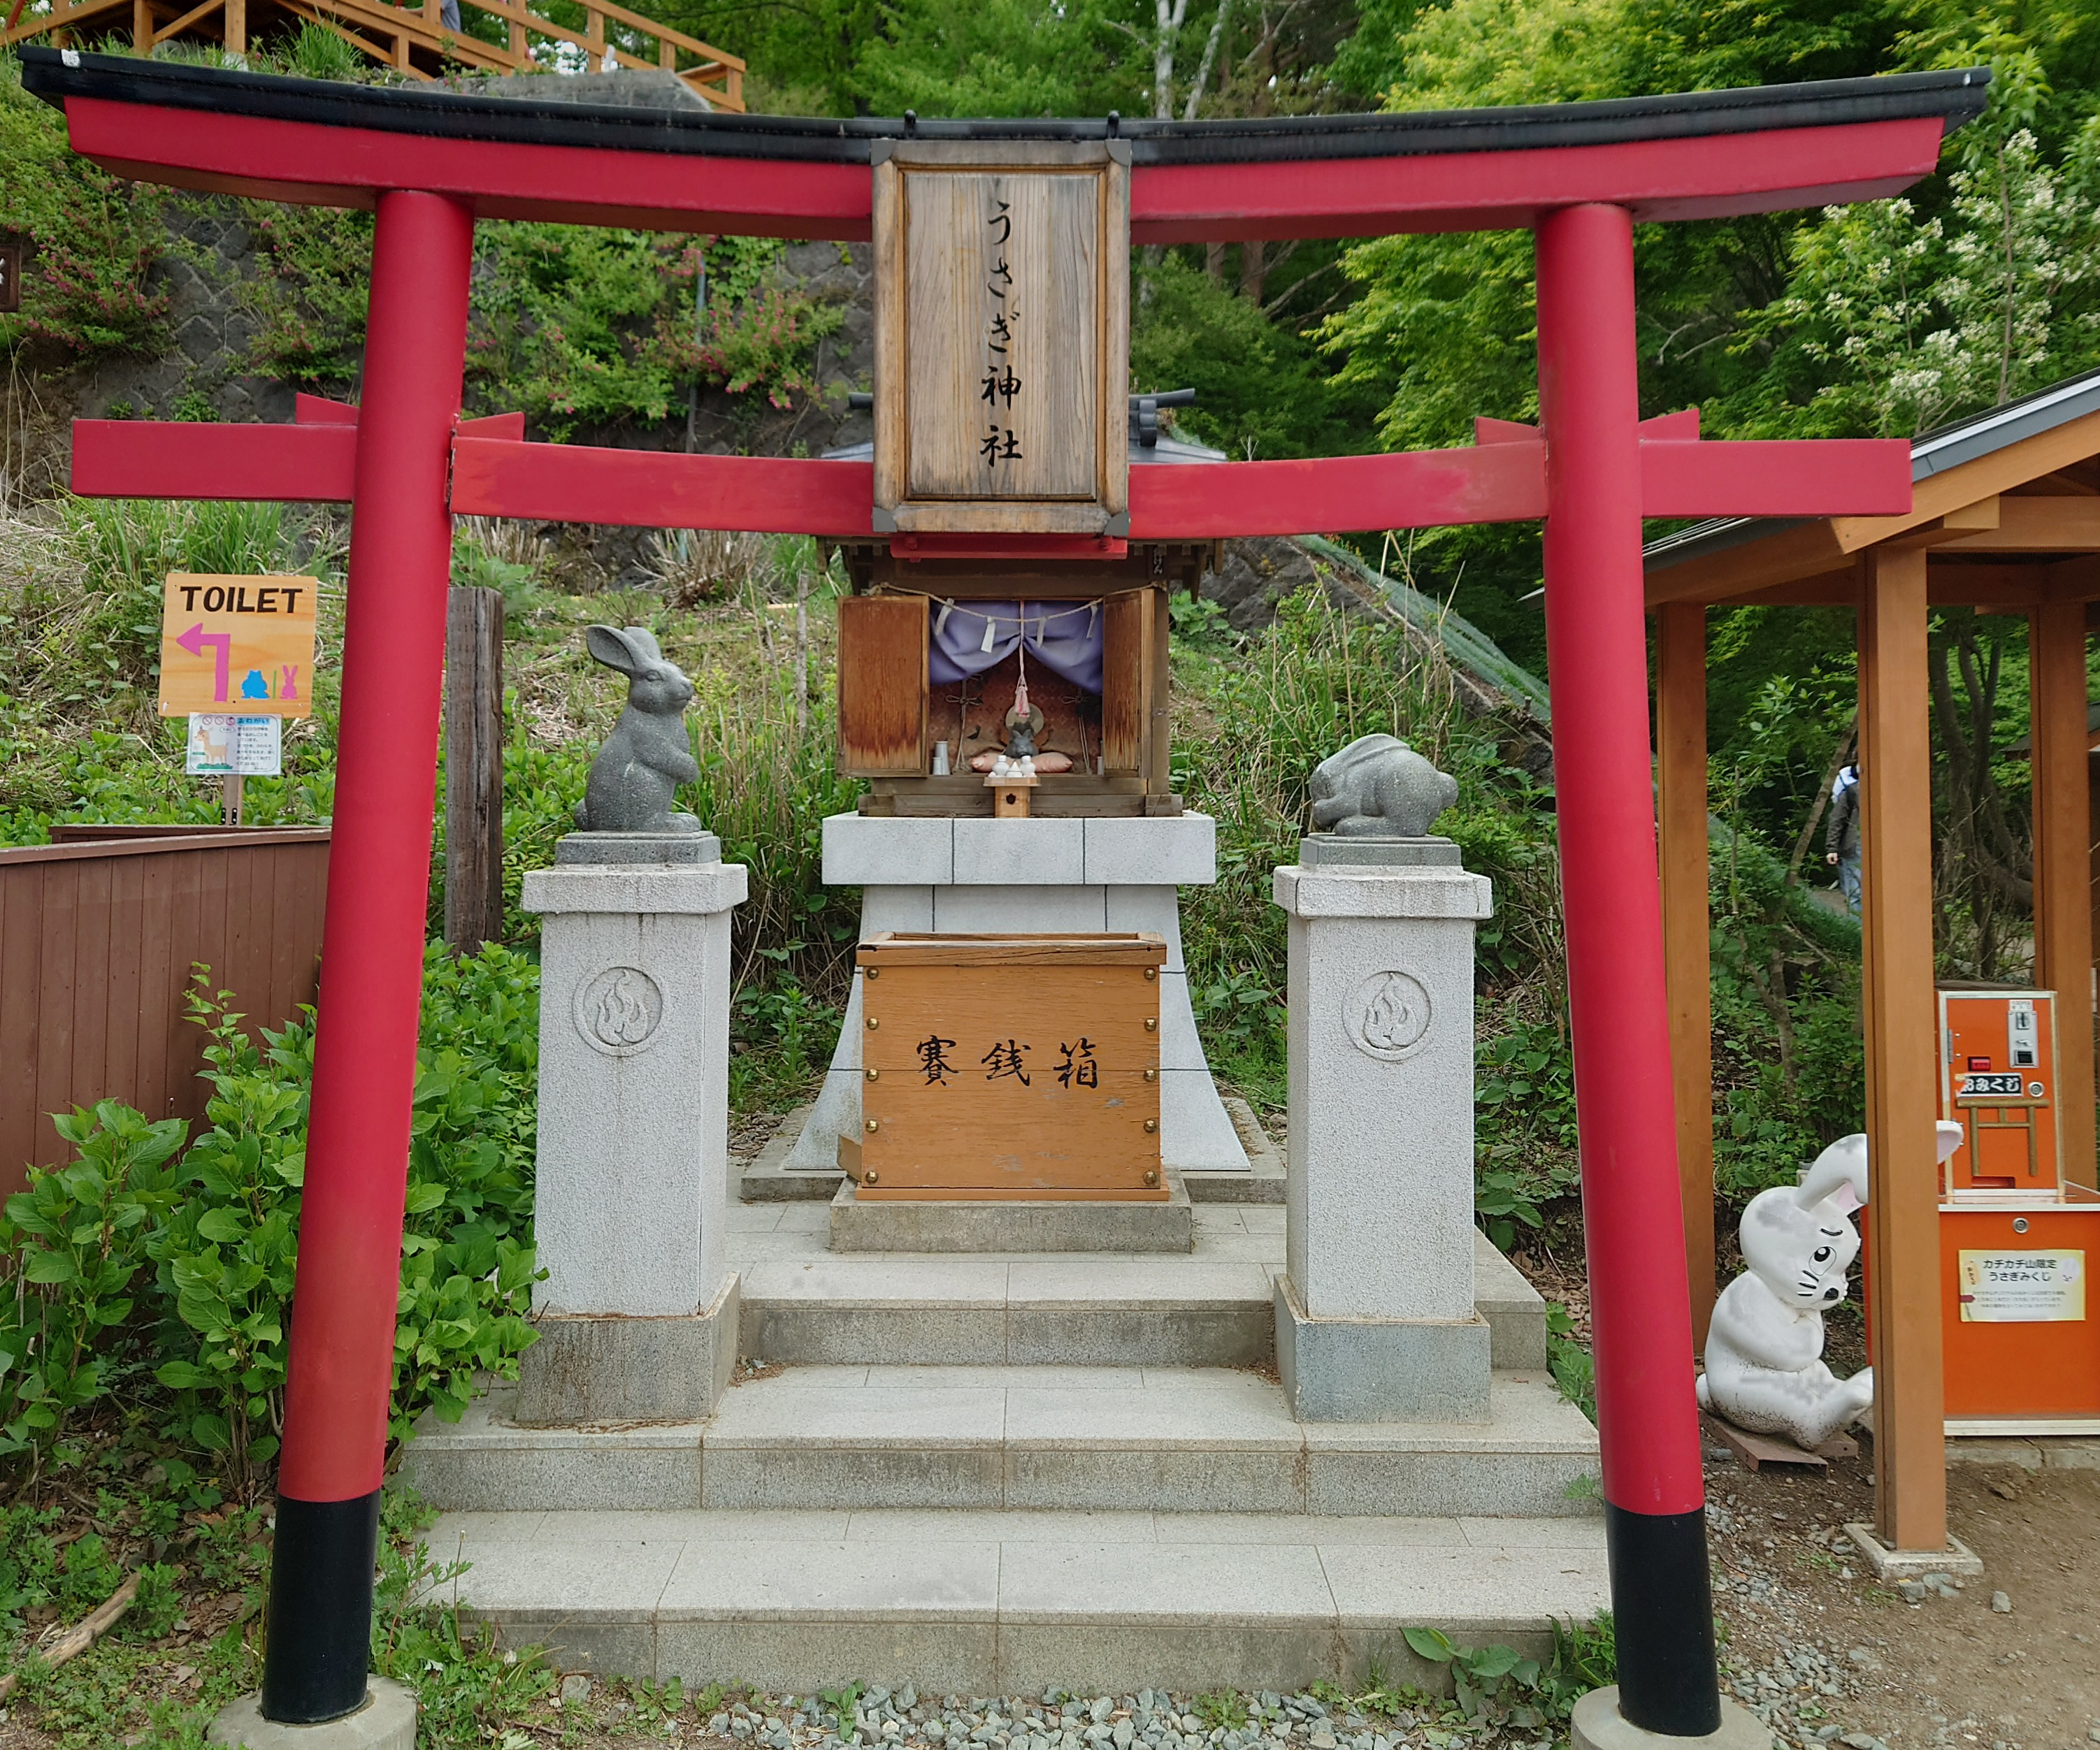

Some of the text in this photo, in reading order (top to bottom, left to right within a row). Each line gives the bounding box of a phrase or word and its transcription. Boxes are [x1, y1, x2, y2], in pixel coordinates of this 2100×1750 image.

[979, 200, 1023, 468] うさぎ神社
[180, 586, 303, 614] TOILET
[916, 1034, 1100, 1089] 賽銭箱
[1983, 1259, 2057, 1268] カチカチ山限定
[1989, 1271, 2052, 1282] うさぎみくじ
